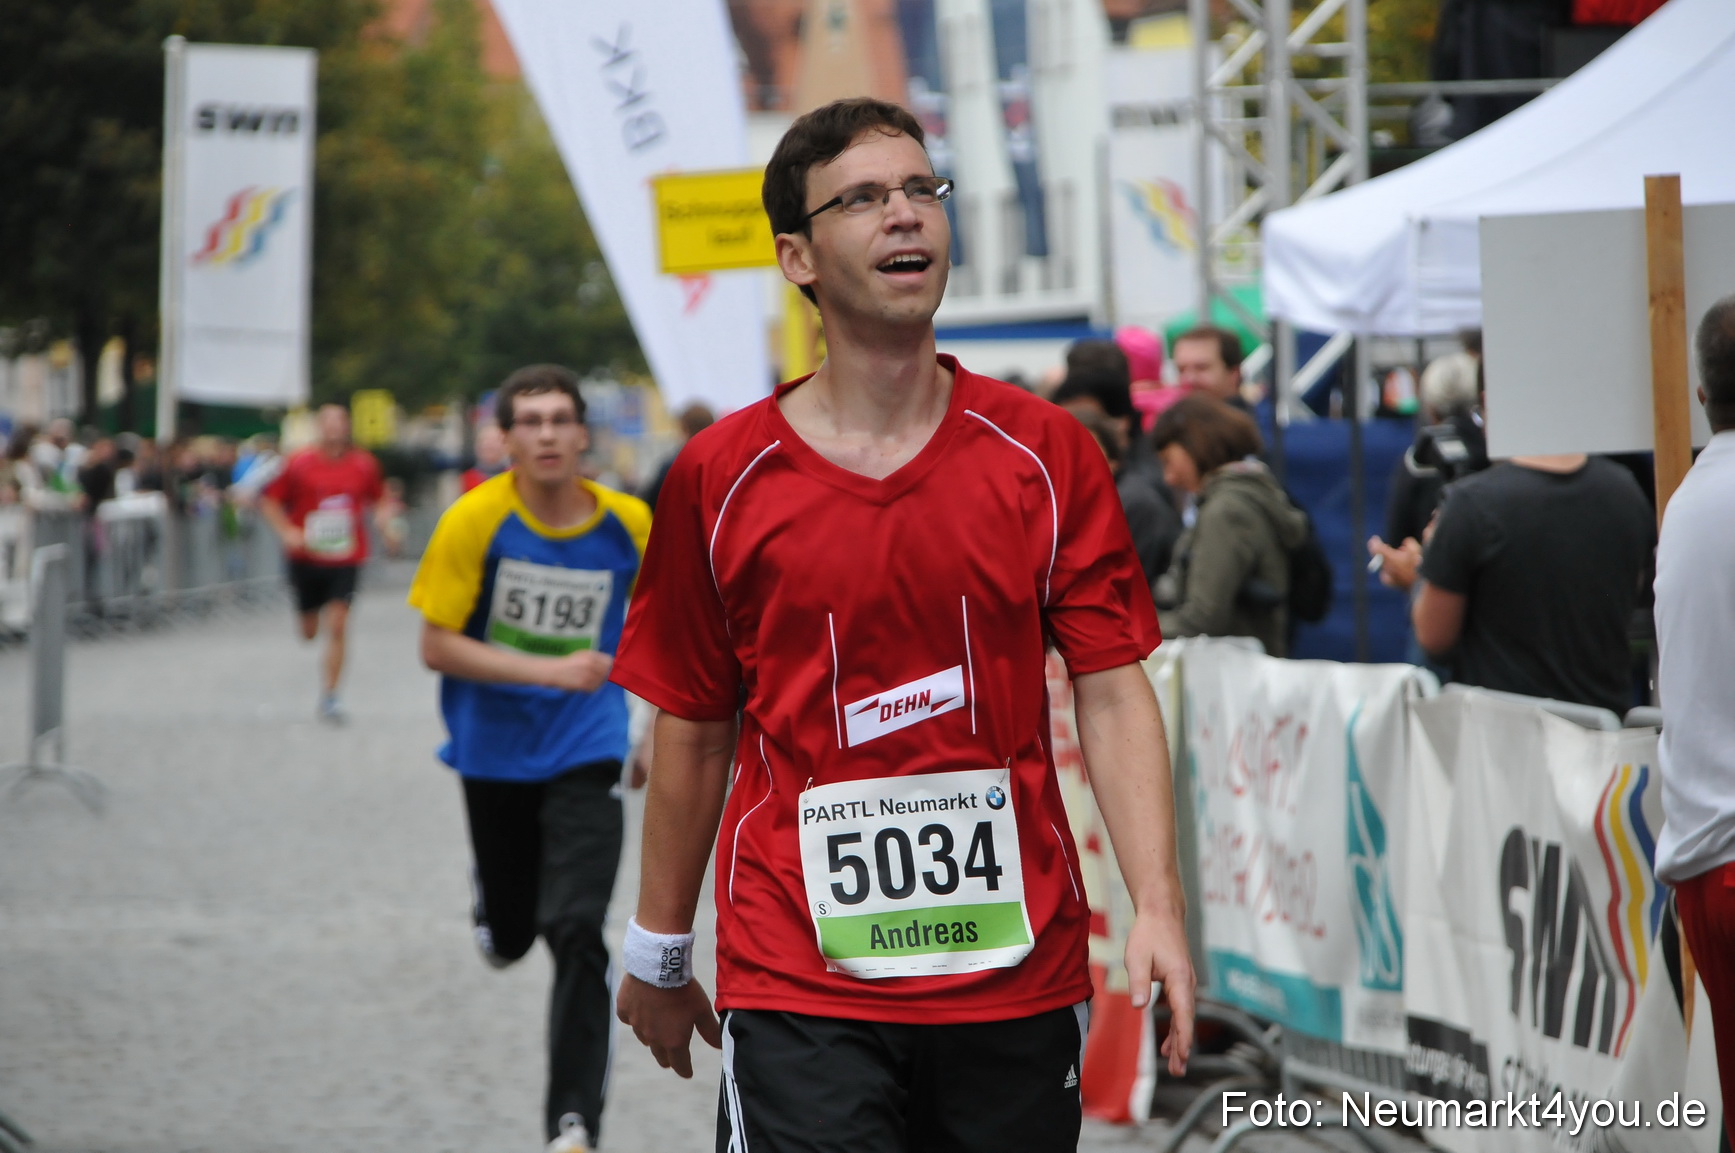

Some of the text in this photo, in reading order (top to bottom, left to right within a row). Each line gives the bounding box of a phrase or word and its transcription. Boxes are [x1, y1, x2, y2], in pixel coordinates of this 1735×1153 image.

[589, 21, 669, 154] BKK
[504, 588, 596, 629] 5193
[879, 689, 932, 723] DEHN
[803, 792, 978, 825] PARTL Neumarkt
[826, 820, 1003, 906] 5034
[818, 903, 827, 915] S
[870, 919, 979, 950] Andreas
